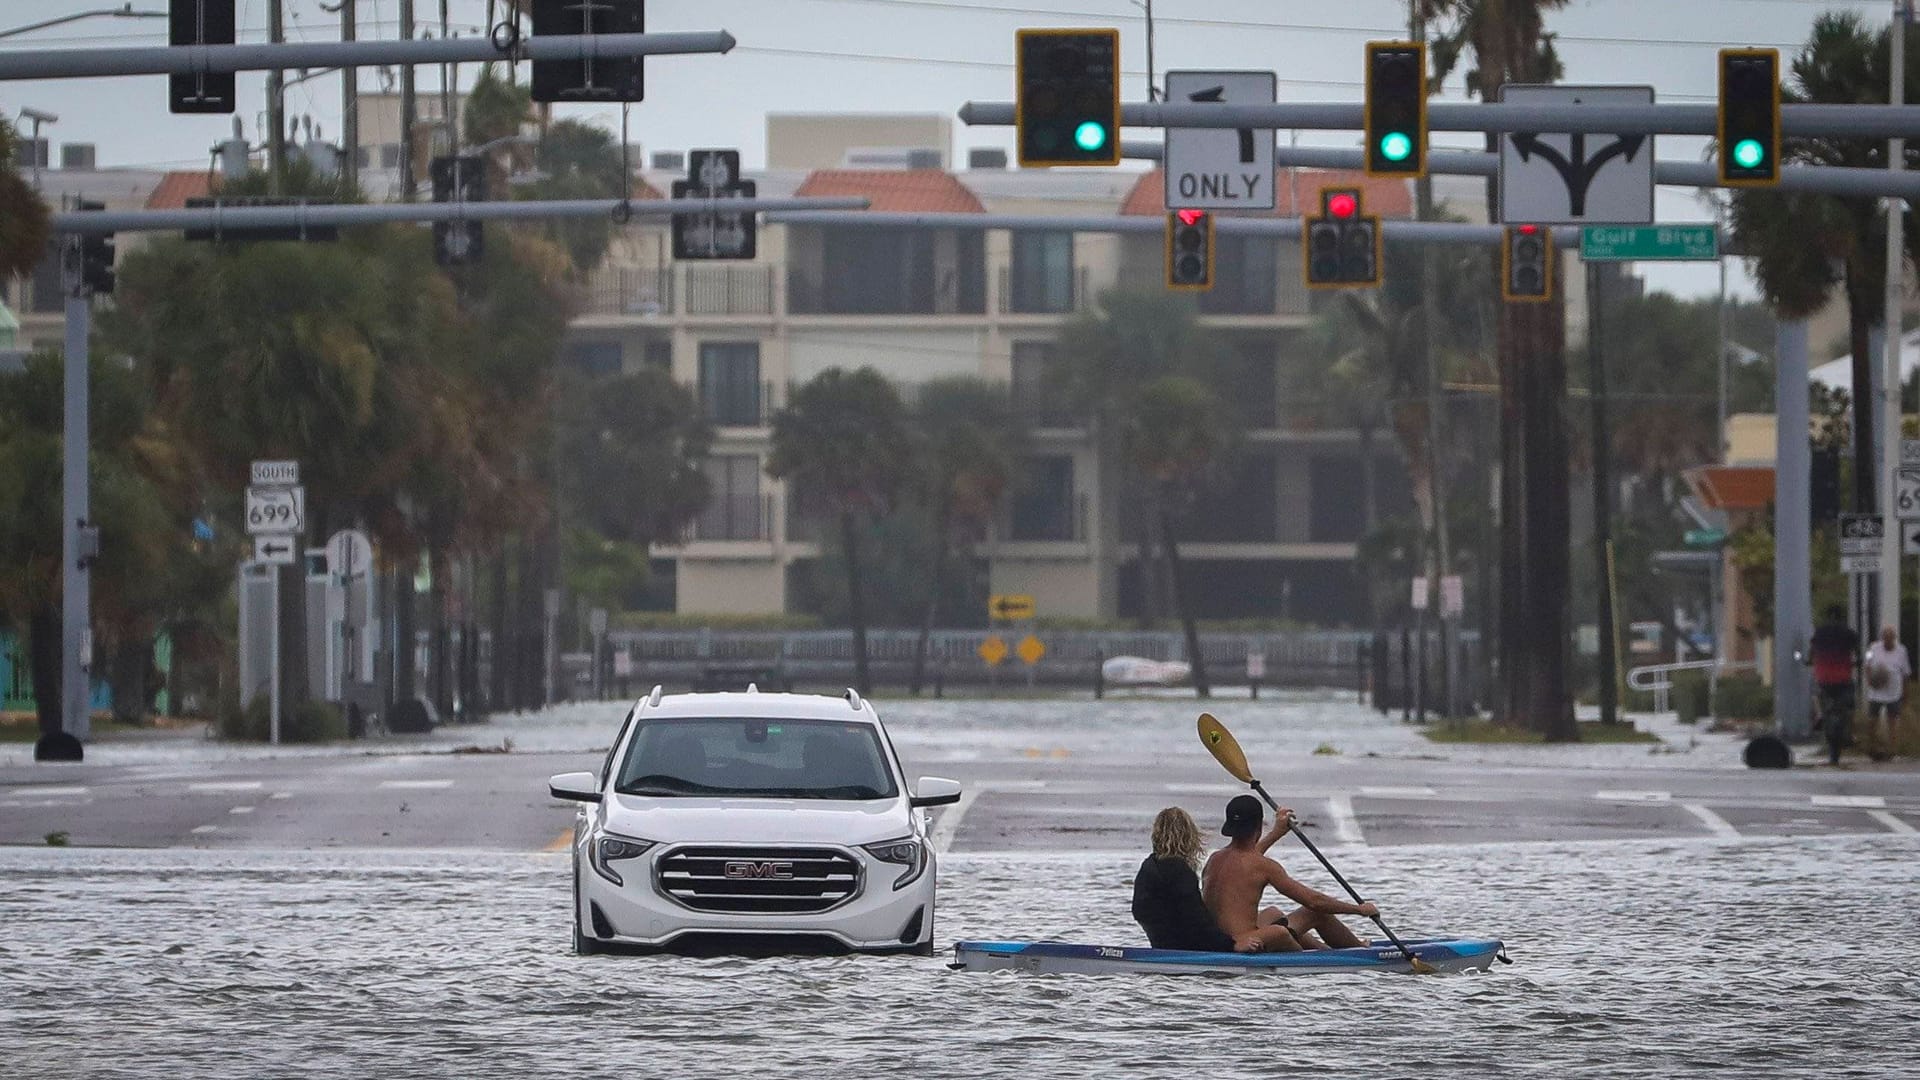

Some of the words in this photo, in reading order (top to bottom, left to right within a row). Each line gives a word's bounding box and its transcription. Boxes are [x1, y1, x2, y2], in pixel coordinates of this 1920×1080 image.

[1179, 172, 1260, 198] ONLY
[1591, 229, 1636, 245] Gulf
[1657, 228, 1707, 245] Blvd
[254, 467, 295, 479] SOUTH
[250, 504, 290, 524] 699
[725, 861, 793, 879] GMC
